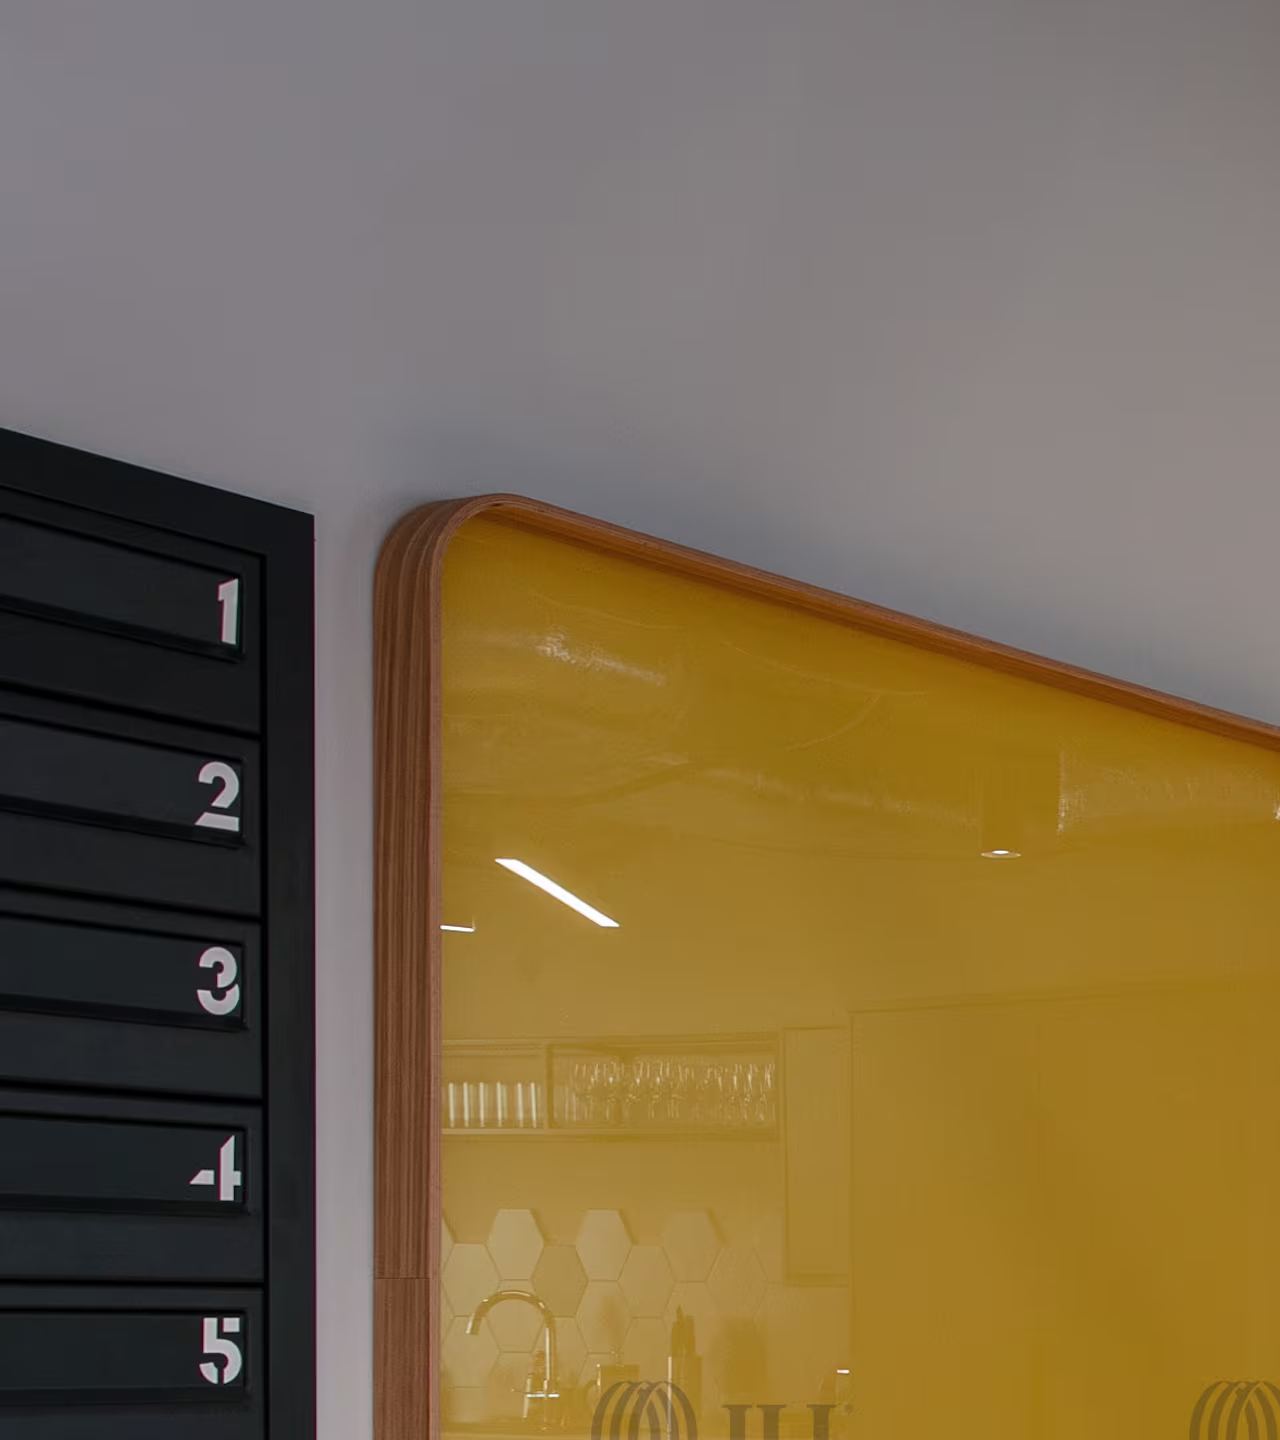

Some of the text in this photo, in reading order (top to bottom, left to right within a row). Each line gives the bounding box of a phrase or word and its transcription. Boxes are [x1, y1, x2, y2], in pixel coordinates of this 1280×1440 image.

[217, 579, 240, 645] 1
[195, 761, 240, 832] 2
[197, 947, 240, 1015] 3
[189, 1135, 242, 1201] 4
[199, 1317, 242, 1385] 5
